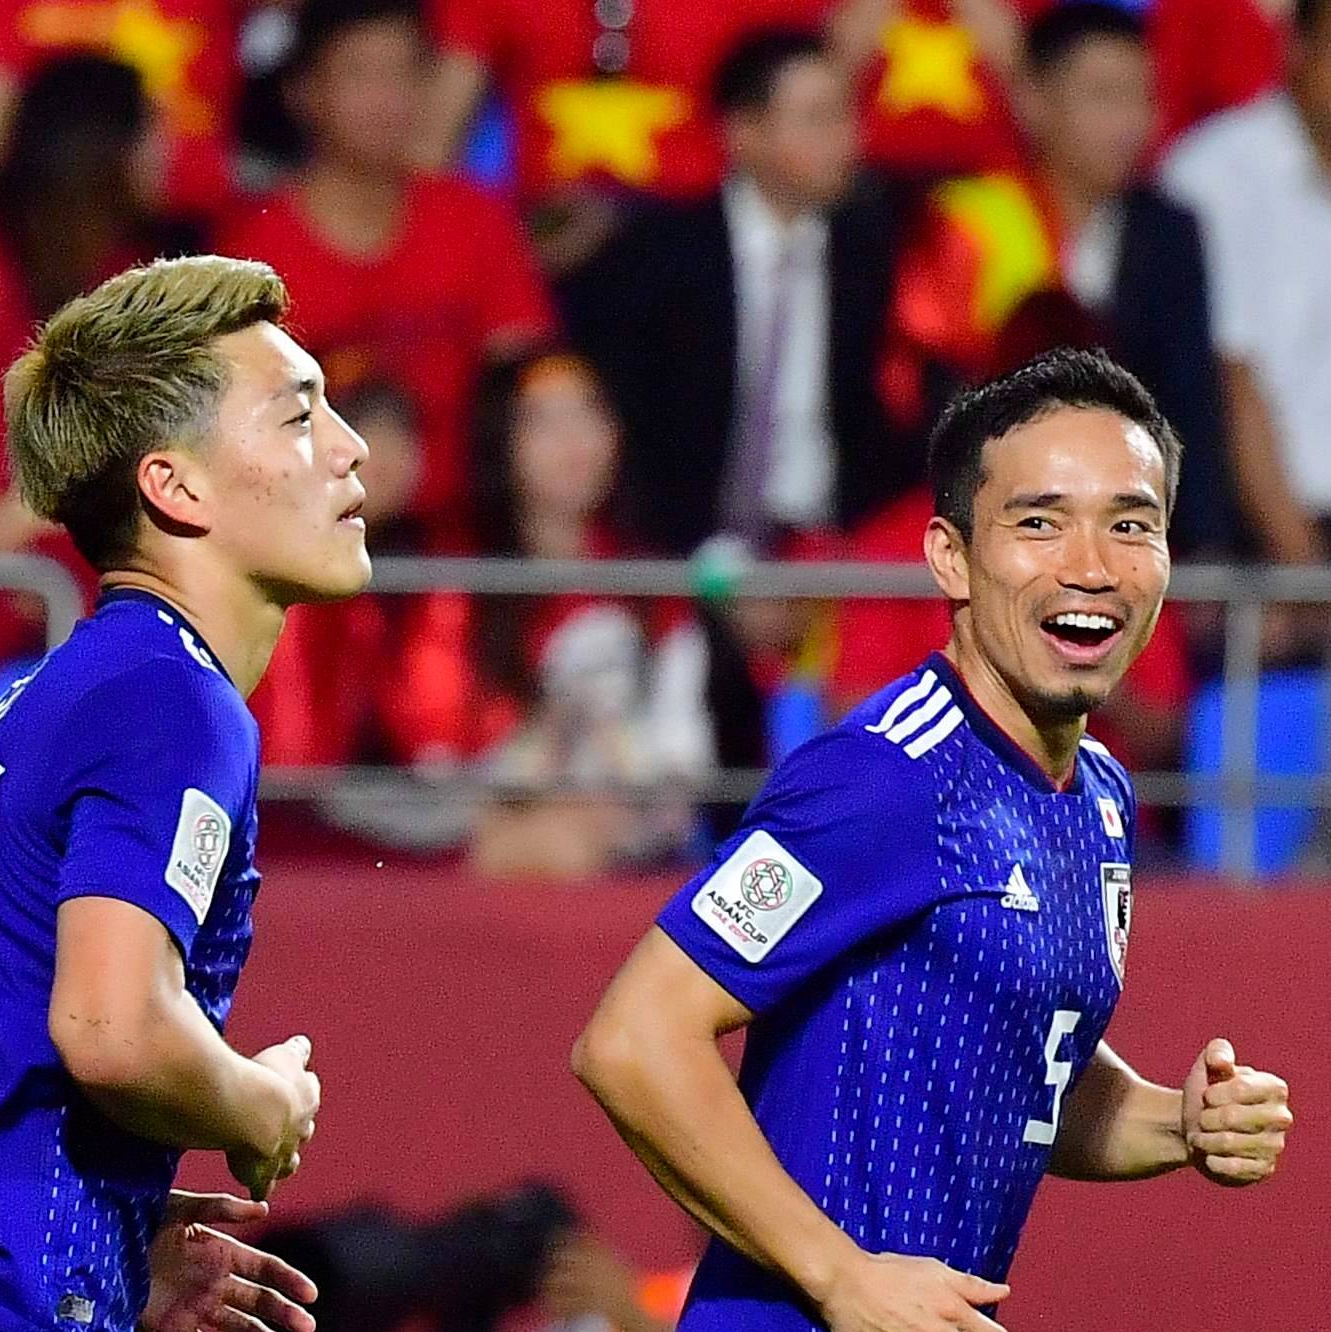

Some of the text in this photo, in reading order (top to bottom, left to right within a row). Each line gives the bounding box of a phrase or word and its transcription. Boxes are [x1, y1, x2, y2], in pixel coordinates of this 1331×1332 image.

[707, 890, 769, 944] ASIAN CUP
[733, 900, 755, 920] AFC
[1022, 1009, 1082, 1145] 5
